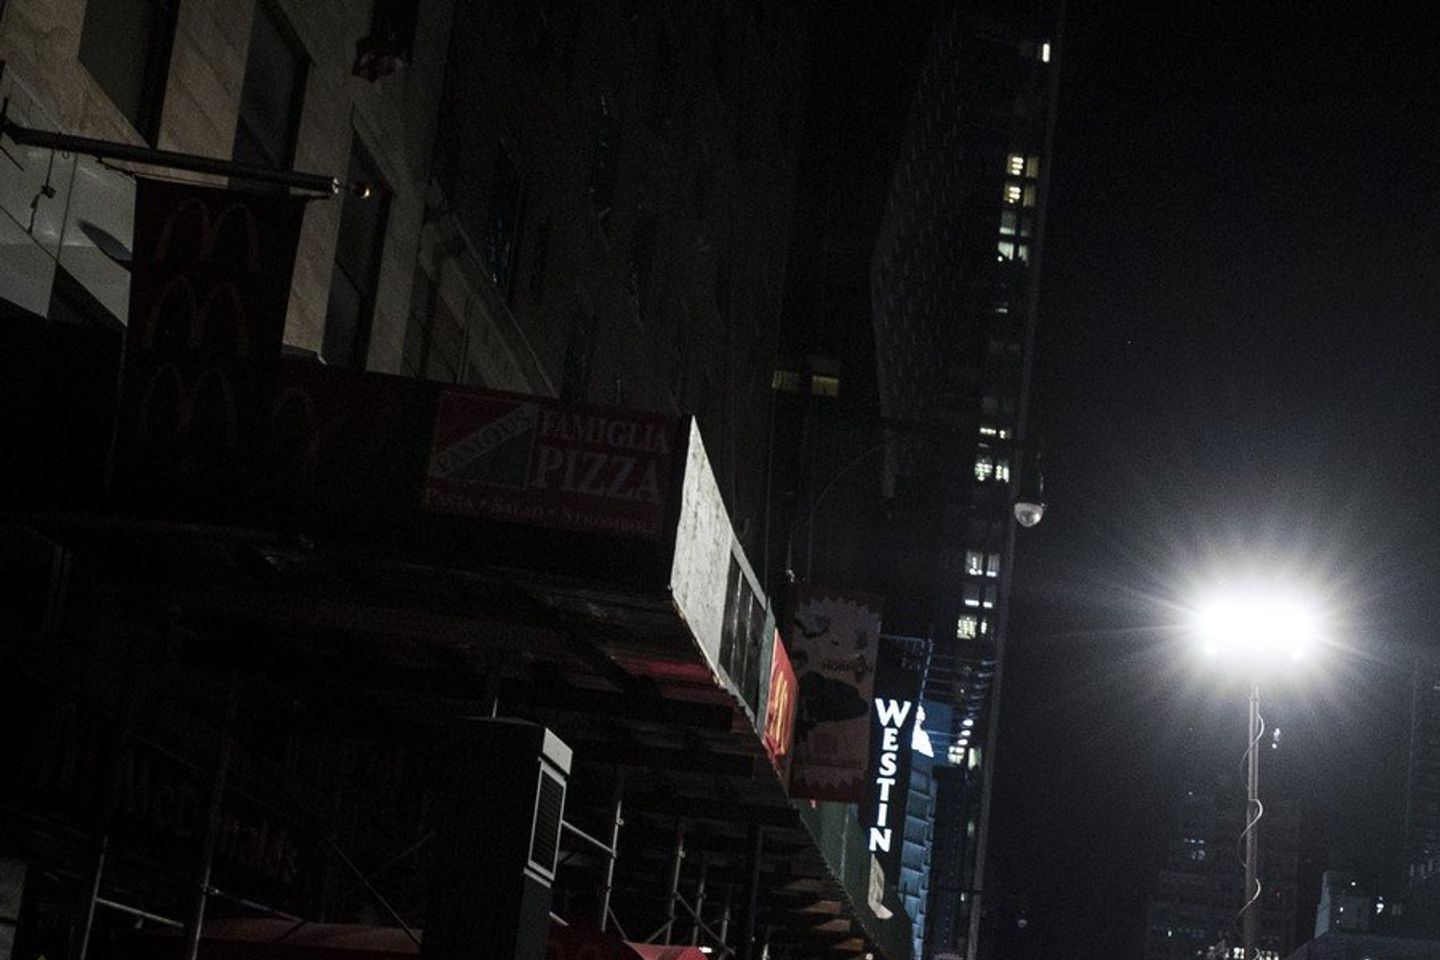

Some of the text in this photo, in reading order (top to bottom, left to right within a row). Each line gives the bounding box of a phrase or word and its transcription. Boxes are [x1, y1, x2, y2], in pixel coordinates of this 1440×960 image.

[540, 409, 670, 454] FAMIGLIA
[531, 445, 665, 504] PIZZA
[869, 698, 912, 853] WESTIN
